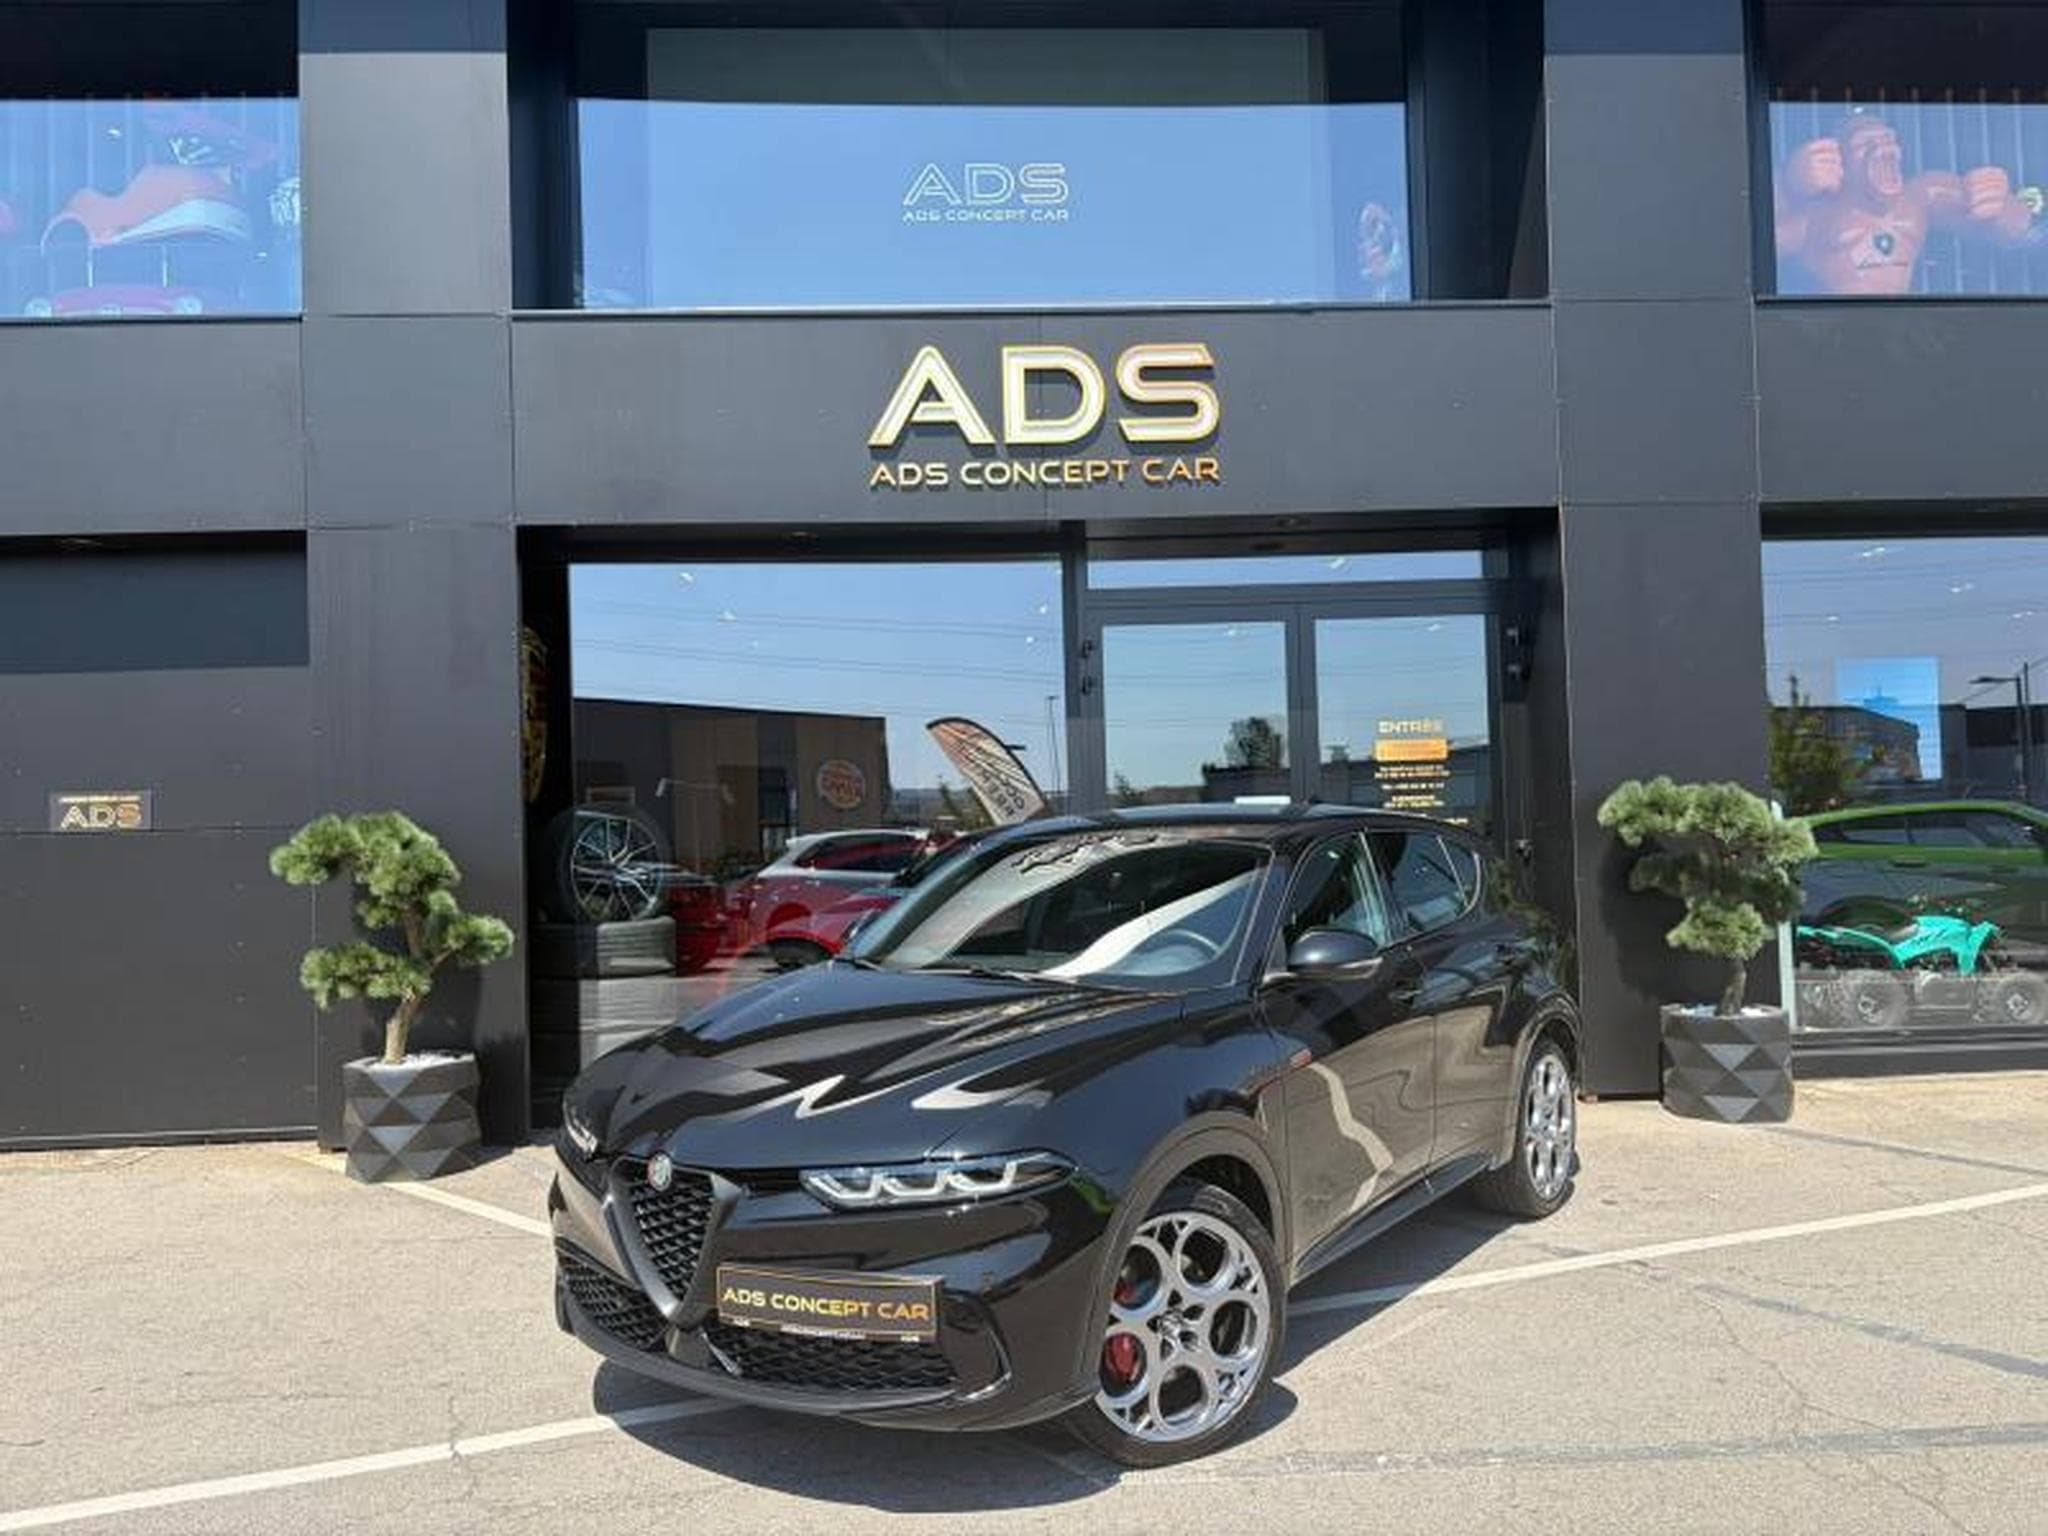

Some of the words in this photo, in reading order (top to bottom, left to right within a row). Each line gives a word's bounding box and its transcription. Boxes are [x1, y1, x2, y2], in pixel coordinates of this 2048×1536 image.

[903, 162, 1069, 206] ADS
[903, 209, 941, 222] ADS
[945, 209, 1025, 222] CONCEPT
[1031, 208, 1069, 222] CAR
[867, 343, 1221, 447] ADS
[869, 462, 949, 486] ADS
[960, 459, 1130, 486] CONCEPT
[1142, 456, 1221, 483] CAR
[60, 803, 142, 829] ADS
[722, 1287, 766, 1307] ADS
[771, 1293, 872, 1318] CONCEPT
[877, 1302, 930, 1321] CAR
